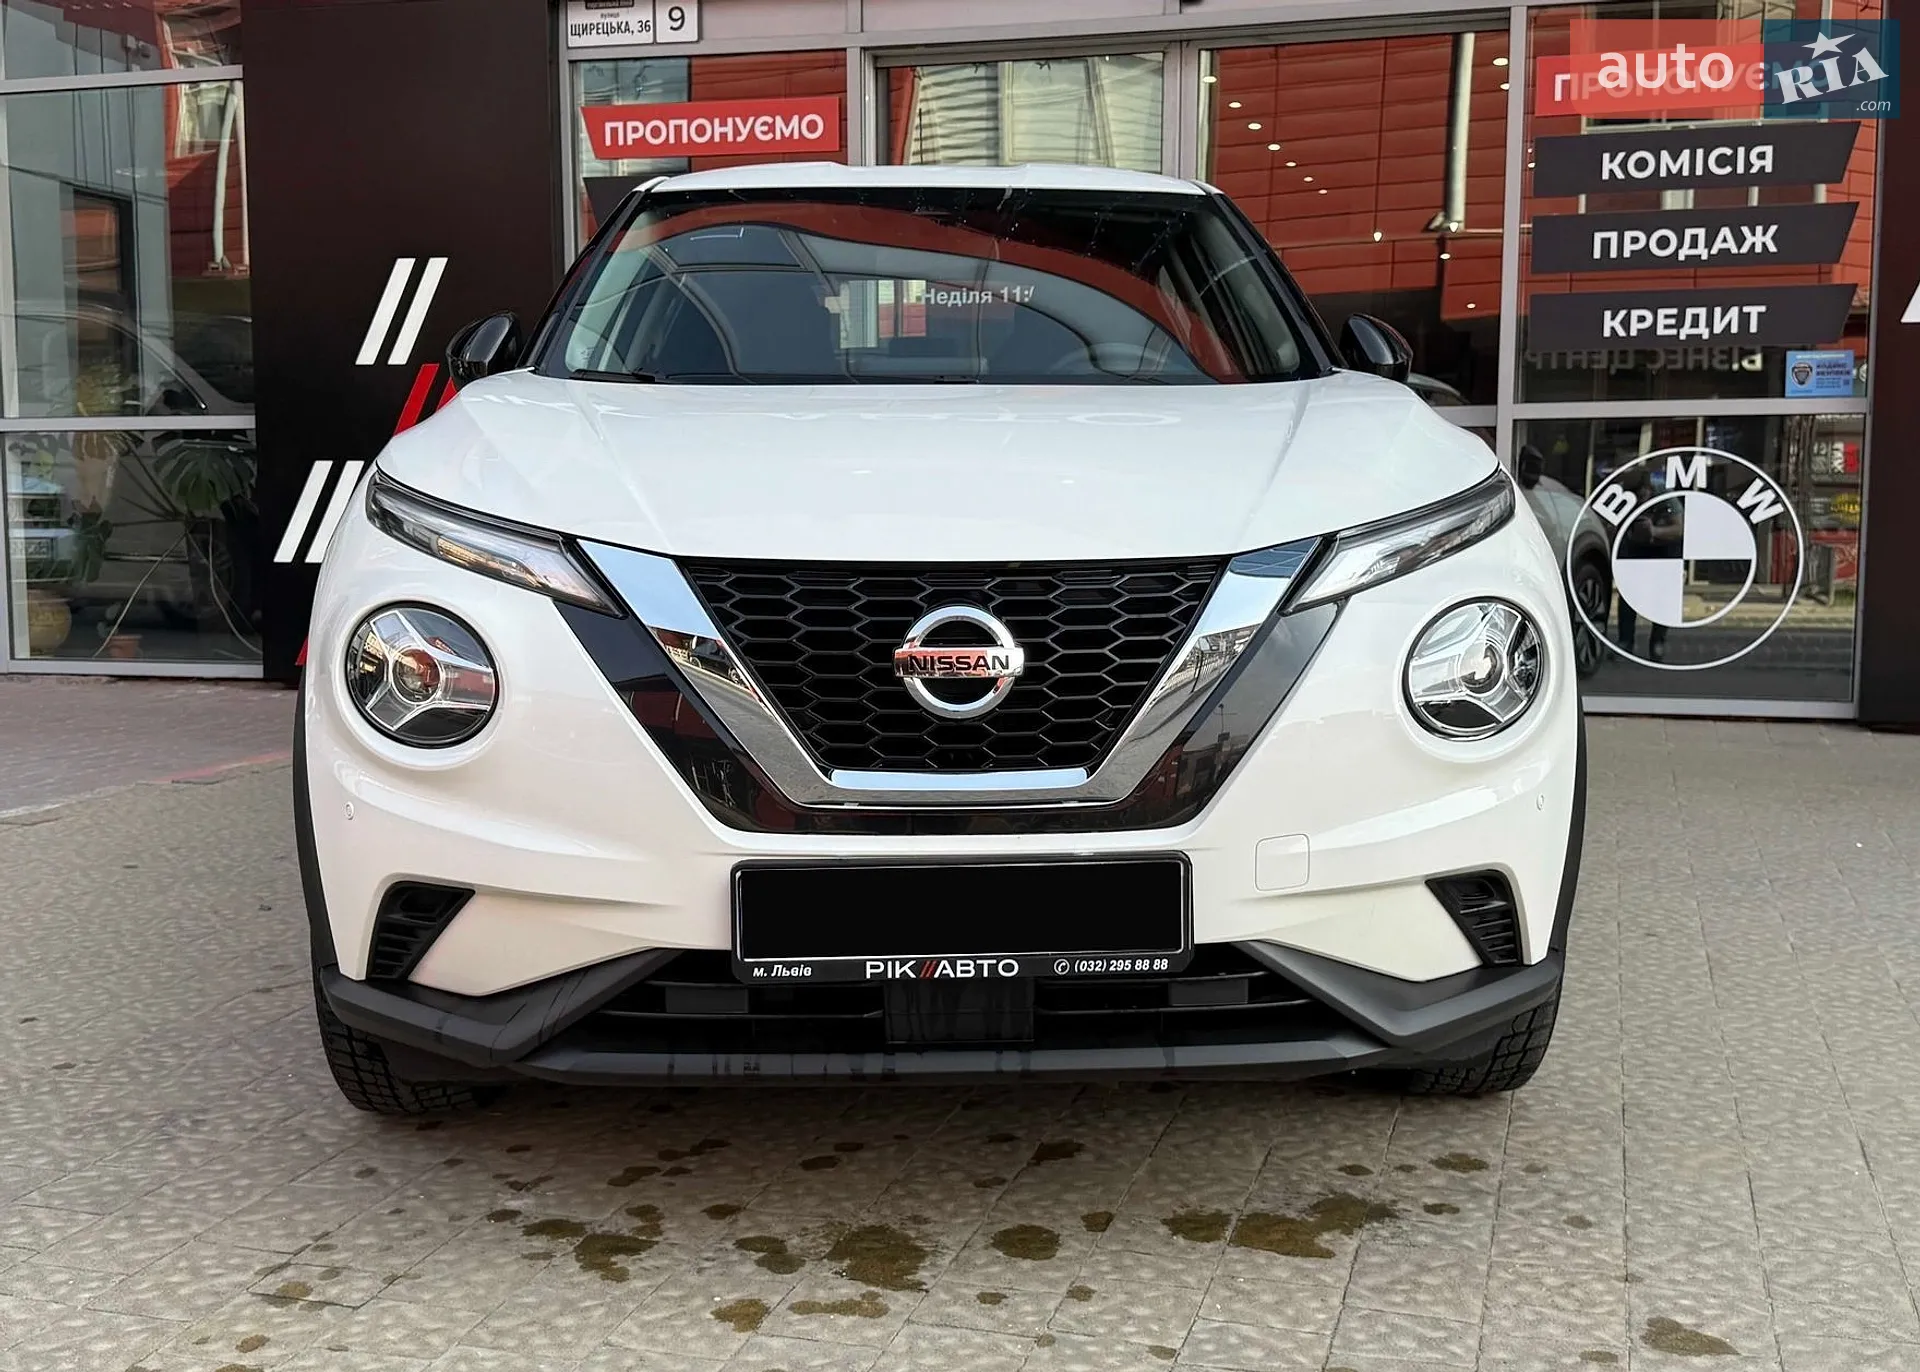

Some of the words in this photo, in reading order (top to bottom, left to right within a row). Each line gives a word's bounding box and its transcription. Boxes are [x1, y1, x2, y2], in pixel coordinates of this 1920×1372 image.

[570, 20, 635, 39] ЩИРЕЦЬКА,
[637, 19, 651, 33] 36
[668, 6, 686, 31] 9
[604, 113, 825, 147] ПРОПОНУЄМО
[1601, 144, 1775, 181] КОМІСІЯ
[1592, 224, 1780, 261] ПРОДАЖ
[1602, 304, 1768, 340] КРЕДИТ
[1591, 455, 1784, 527] BMW
[907, 653, 1010, 673] NISSAN
[753, 967, 767, 977] м.
[771, 964, 812, 977] Львів
[1074, 959, 1106, 973] (032)
[1109, 958, 1132, 972] 295
[1134, 958, 1150, 971] 88
[1152, 958, 1168, 971] 88
